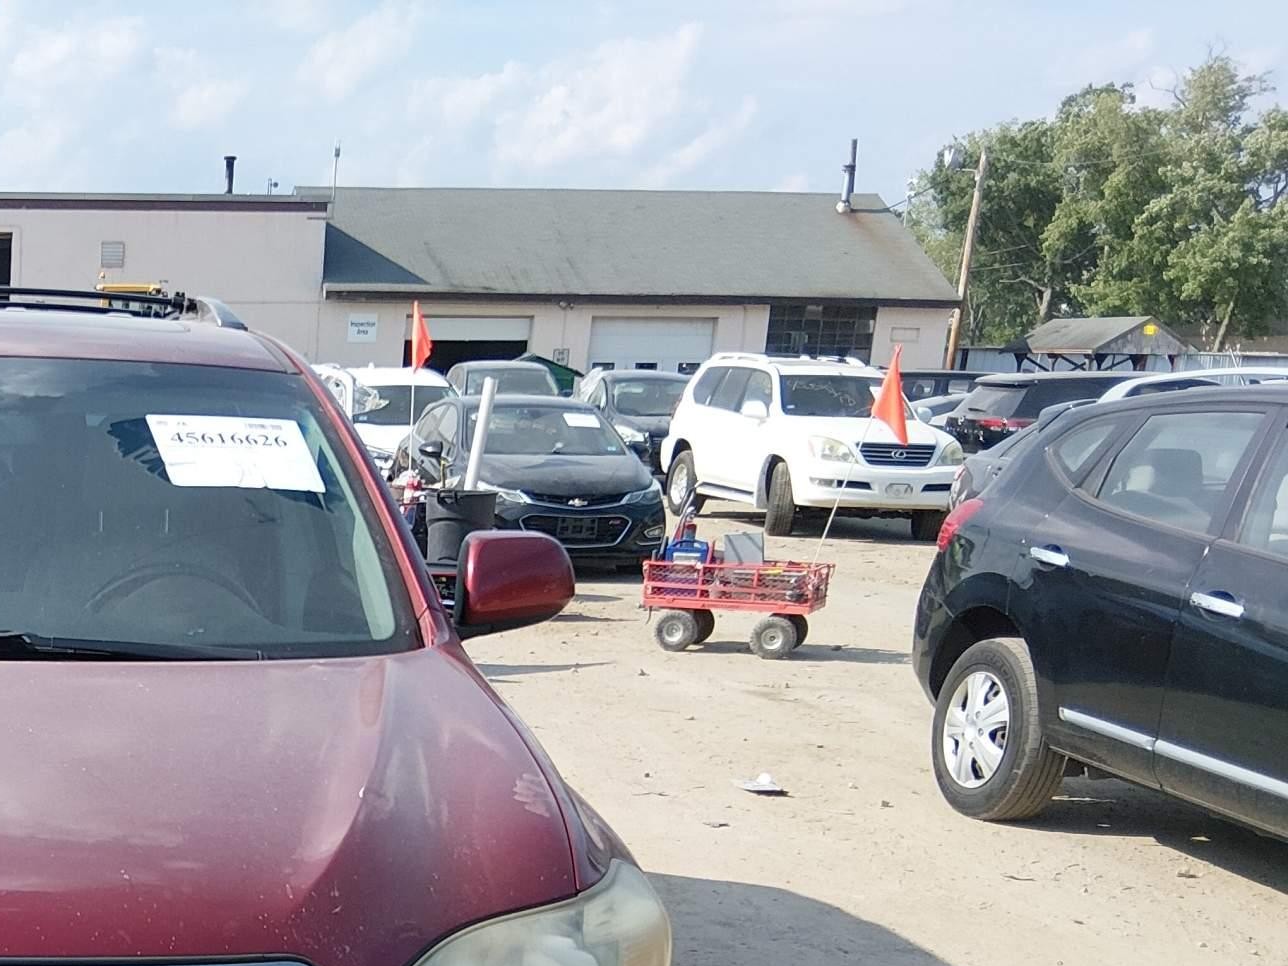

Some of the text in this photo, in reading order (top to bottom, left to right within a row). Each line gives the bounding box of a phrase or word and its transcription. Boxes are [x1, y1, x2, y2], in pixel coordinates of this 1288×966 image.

[350, 320, 376, 329] Inspection
[356, 328, 369, 336] Area
[170, 431, 288, 447] 45616626
